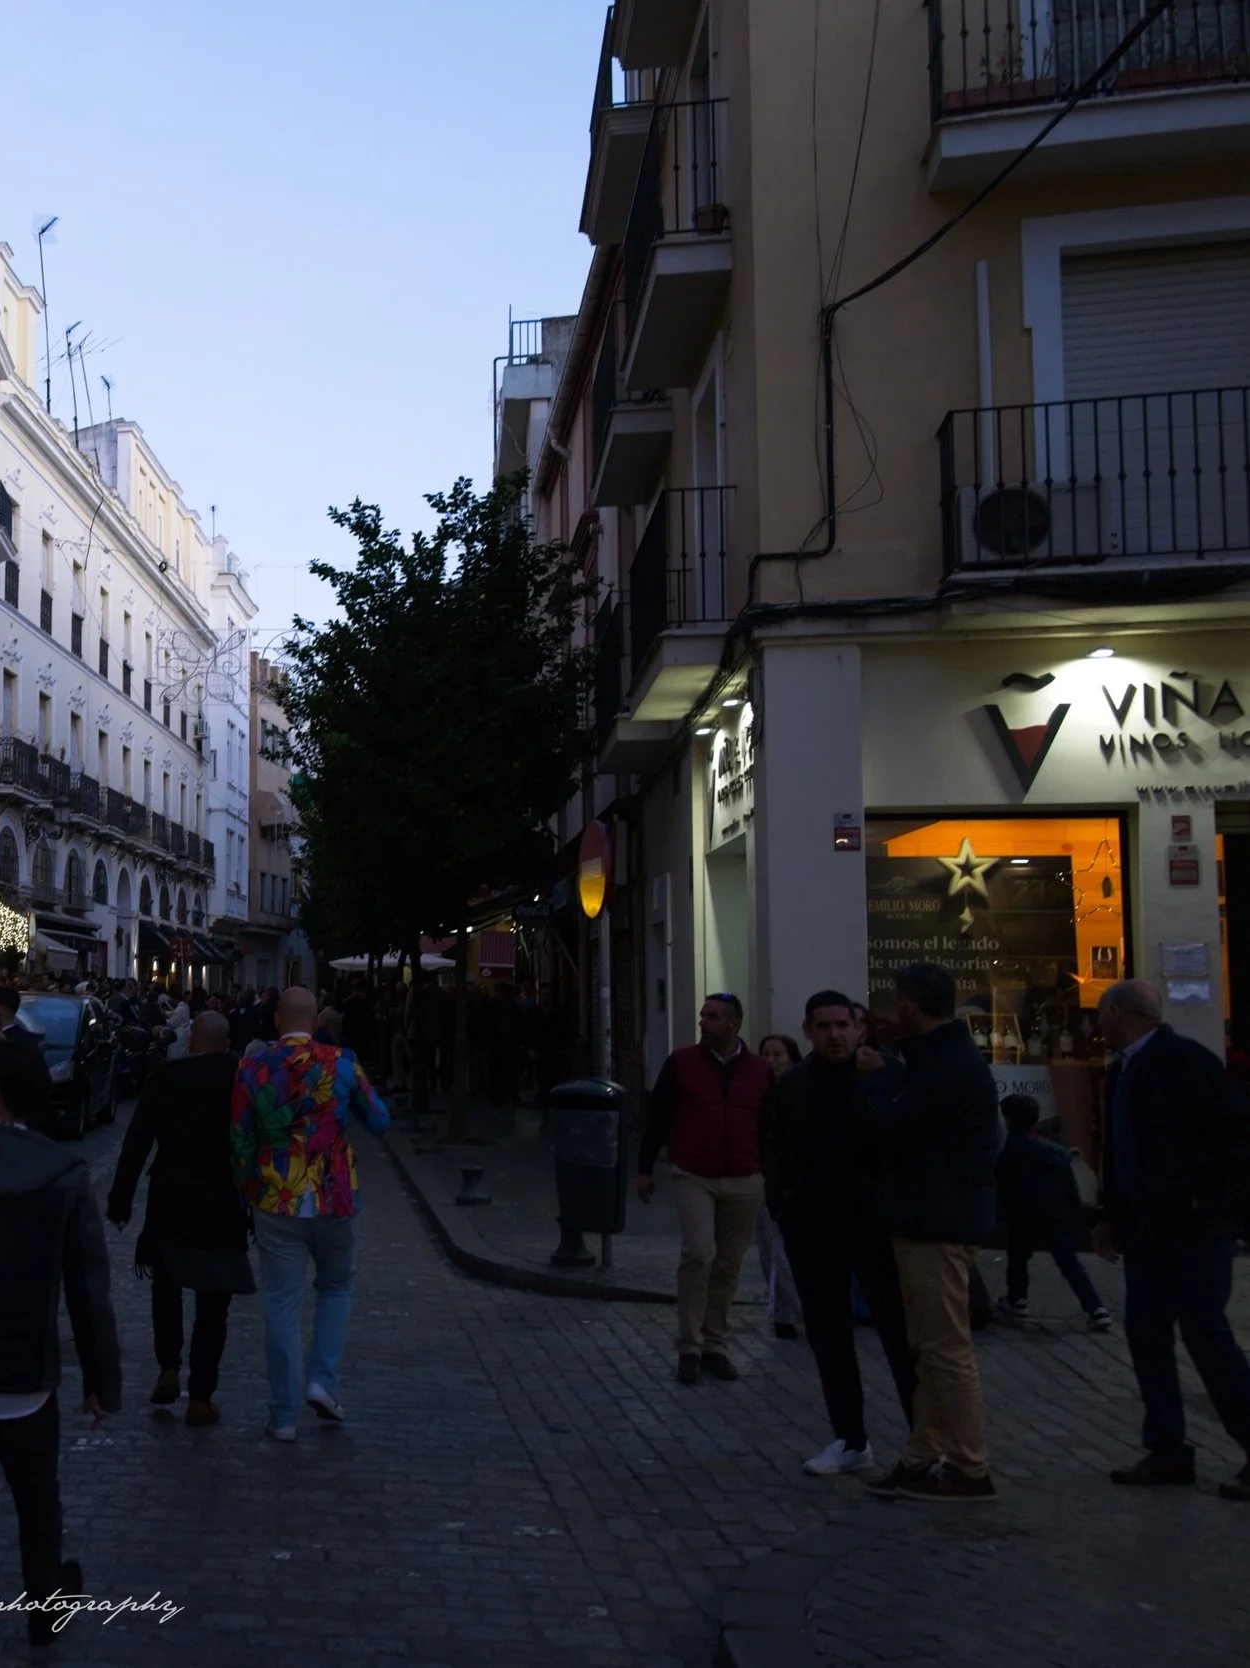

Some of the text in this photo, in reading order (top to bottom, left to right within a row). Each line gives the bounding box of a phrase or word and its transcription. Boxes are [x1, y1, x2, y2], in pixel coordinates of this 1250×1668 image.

[1102, 671, 1245, 726] VIÑA
[1099, 732, 1188, 750] VINOS
[868, 900, 941, 912] EMILIO MORO
[867, 936, 1000, 953] Somos el legado
